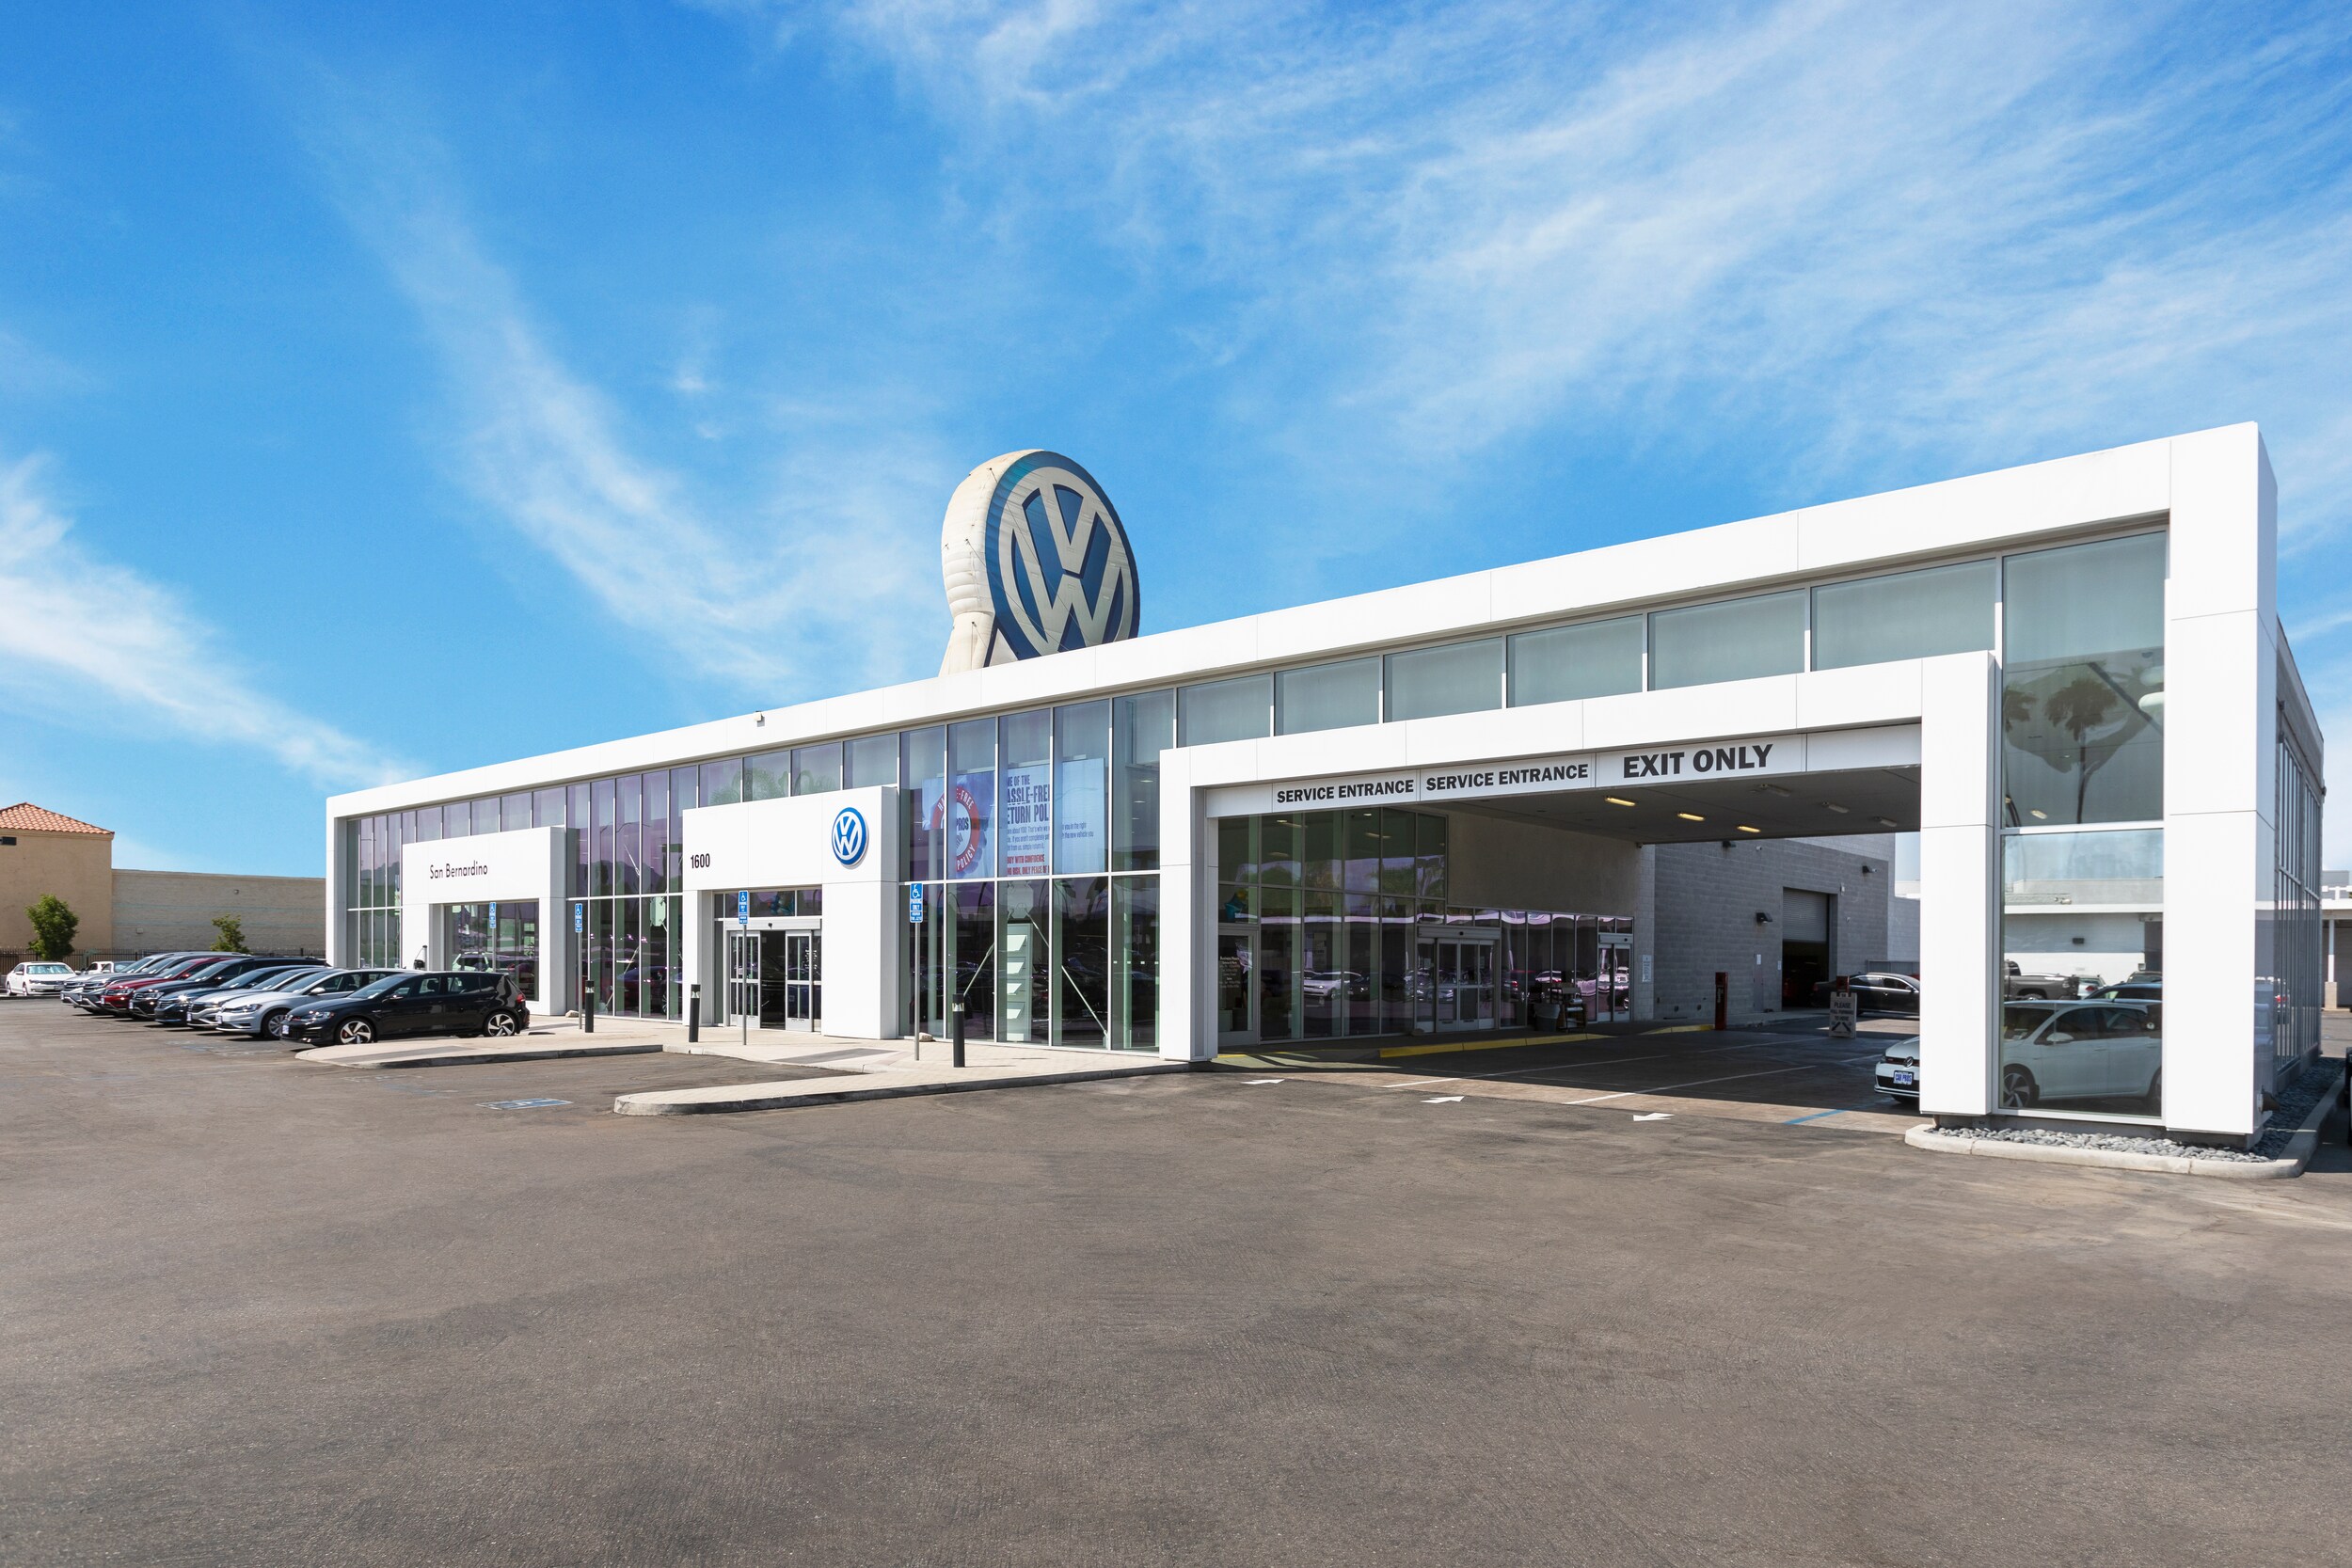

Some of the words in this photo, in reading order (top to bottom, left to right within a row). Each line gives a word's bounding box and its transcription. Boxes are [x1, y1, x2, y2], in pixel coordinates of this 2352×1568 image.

[1623, 752, 1685, 778] EXIT
[1692, 744, 1773, 773] ONLY
[1013, 775, 1020, 786] OF
[1021, 774, 1030, 785] THE
[1425, 772, 1494, 791] SERVICE
[1499, 764, 1588, 784] ENTRANCE
[1007, 784, 1050, 805] ASSLE-FRE
[1277, 786, 1334, 803] SERVICE
[1339, 780, 1414, 799] ENTRANCE
[1007, 805, 1031, 824] TURN
[1033, 803, 1050, 823] POL
[691, 852, 710, 869] 1600
[956, 844, 976, 870] POLICY
[1016, 855, 1025, 863] WITH
[429, 863, 444, 879] San
[445, 860, 488, 878] Bernardino
